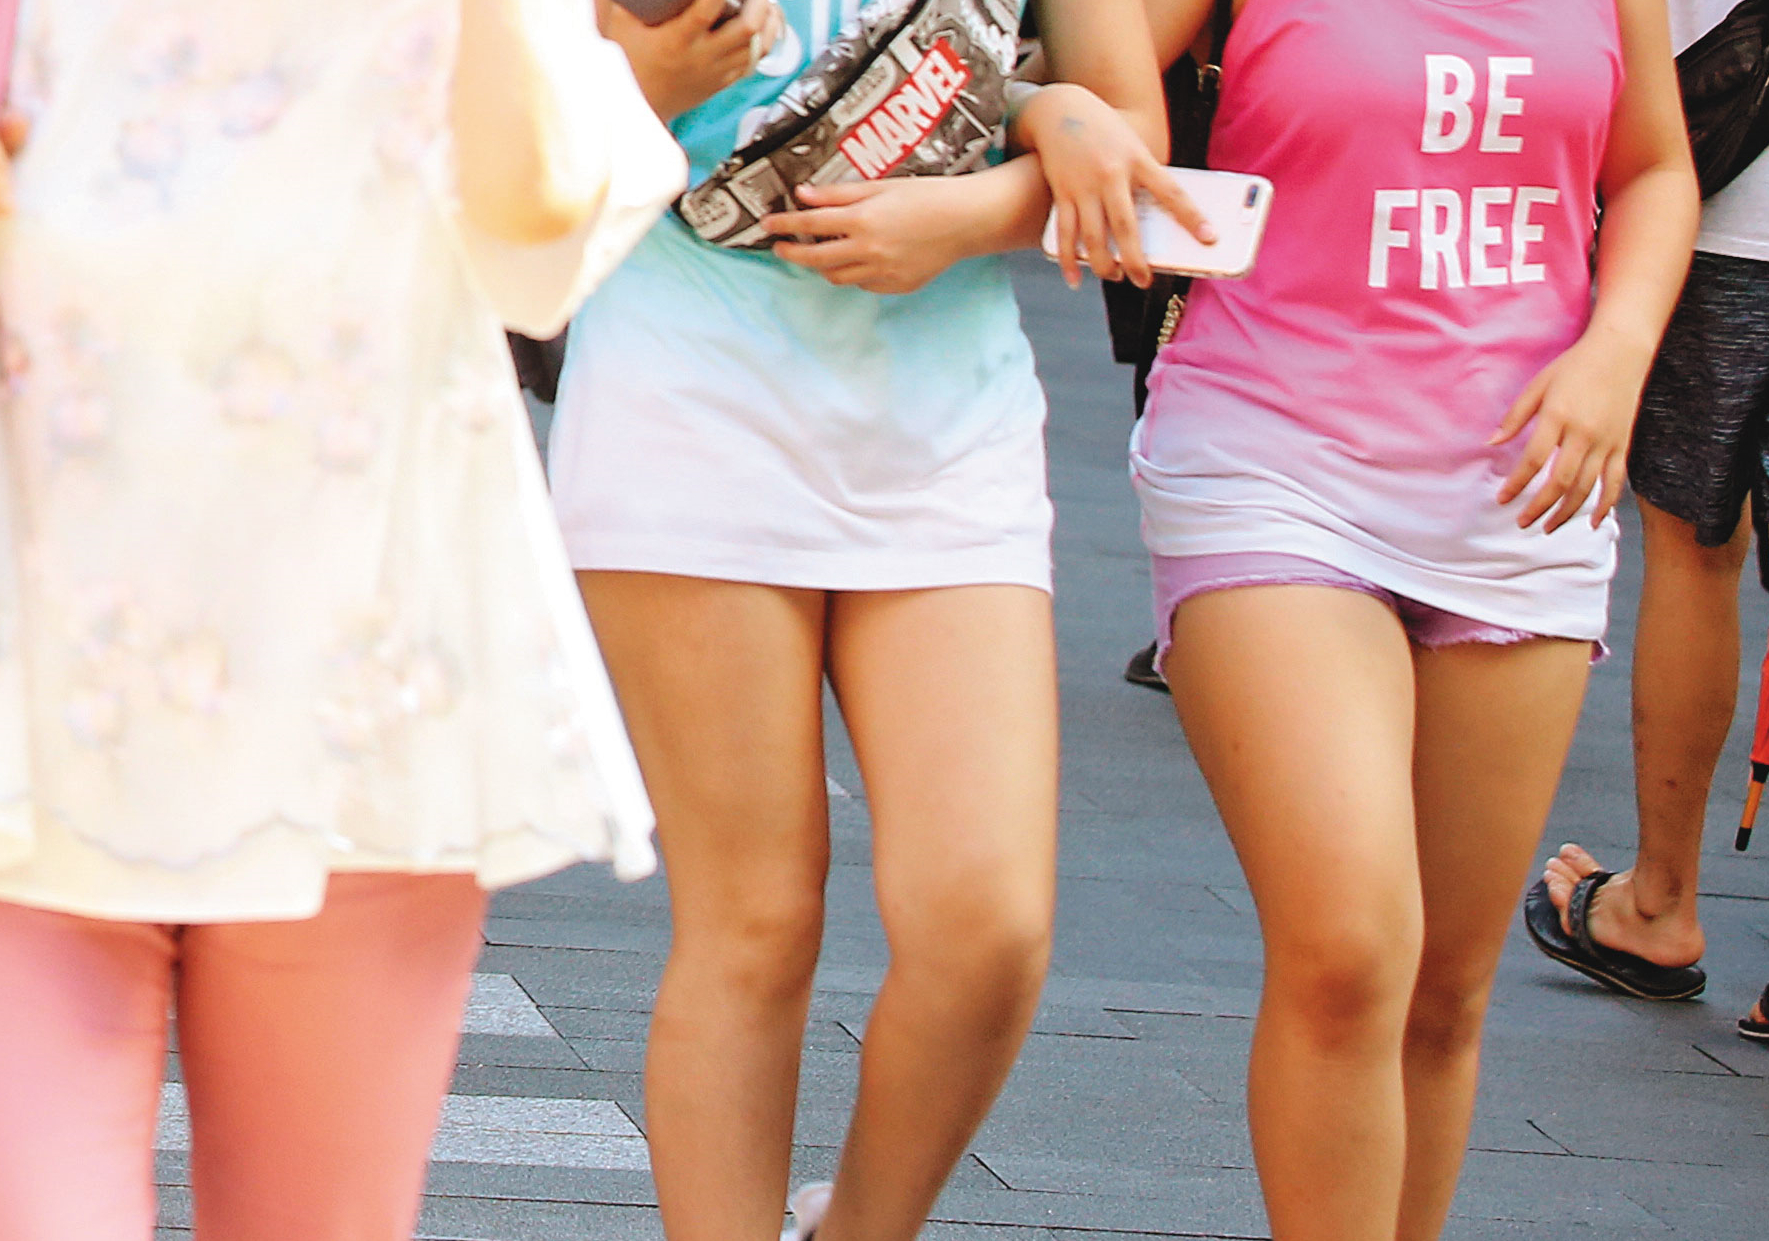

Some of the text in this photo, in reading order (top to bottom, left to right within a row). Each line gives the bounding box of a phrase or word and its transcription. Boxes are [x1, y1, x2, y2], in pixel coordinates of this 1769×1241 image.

[840, 47, 967, 179] MARVEL
[1420, 54, 1533, 154] BE
[1368, 186, 1560, 290] FREE
